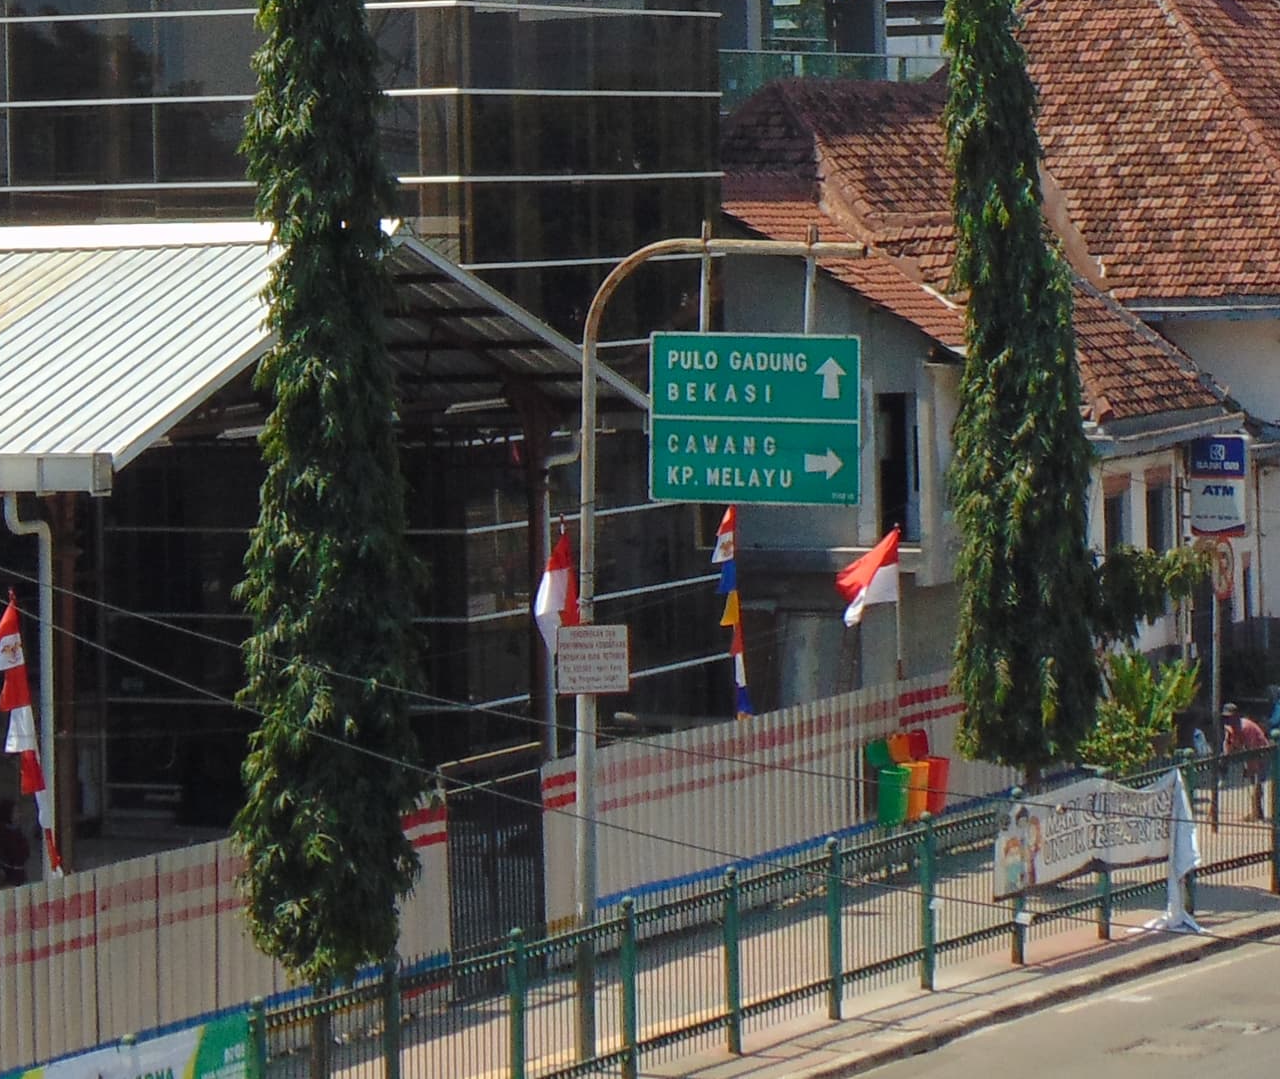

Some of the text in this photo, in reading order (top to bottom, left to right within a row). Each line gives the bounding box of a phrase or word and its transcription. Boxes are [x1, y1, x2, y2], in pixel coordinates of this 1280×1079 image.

[668, 350, 807, 372] PULO GADUNG
[668, 383, 771, 403] BEKASI
[668, 434, 776, 455] CAWANG
[668, 466, 793, 488] KP. MELAYU
[1202, 485, 1234, 496] ATM
